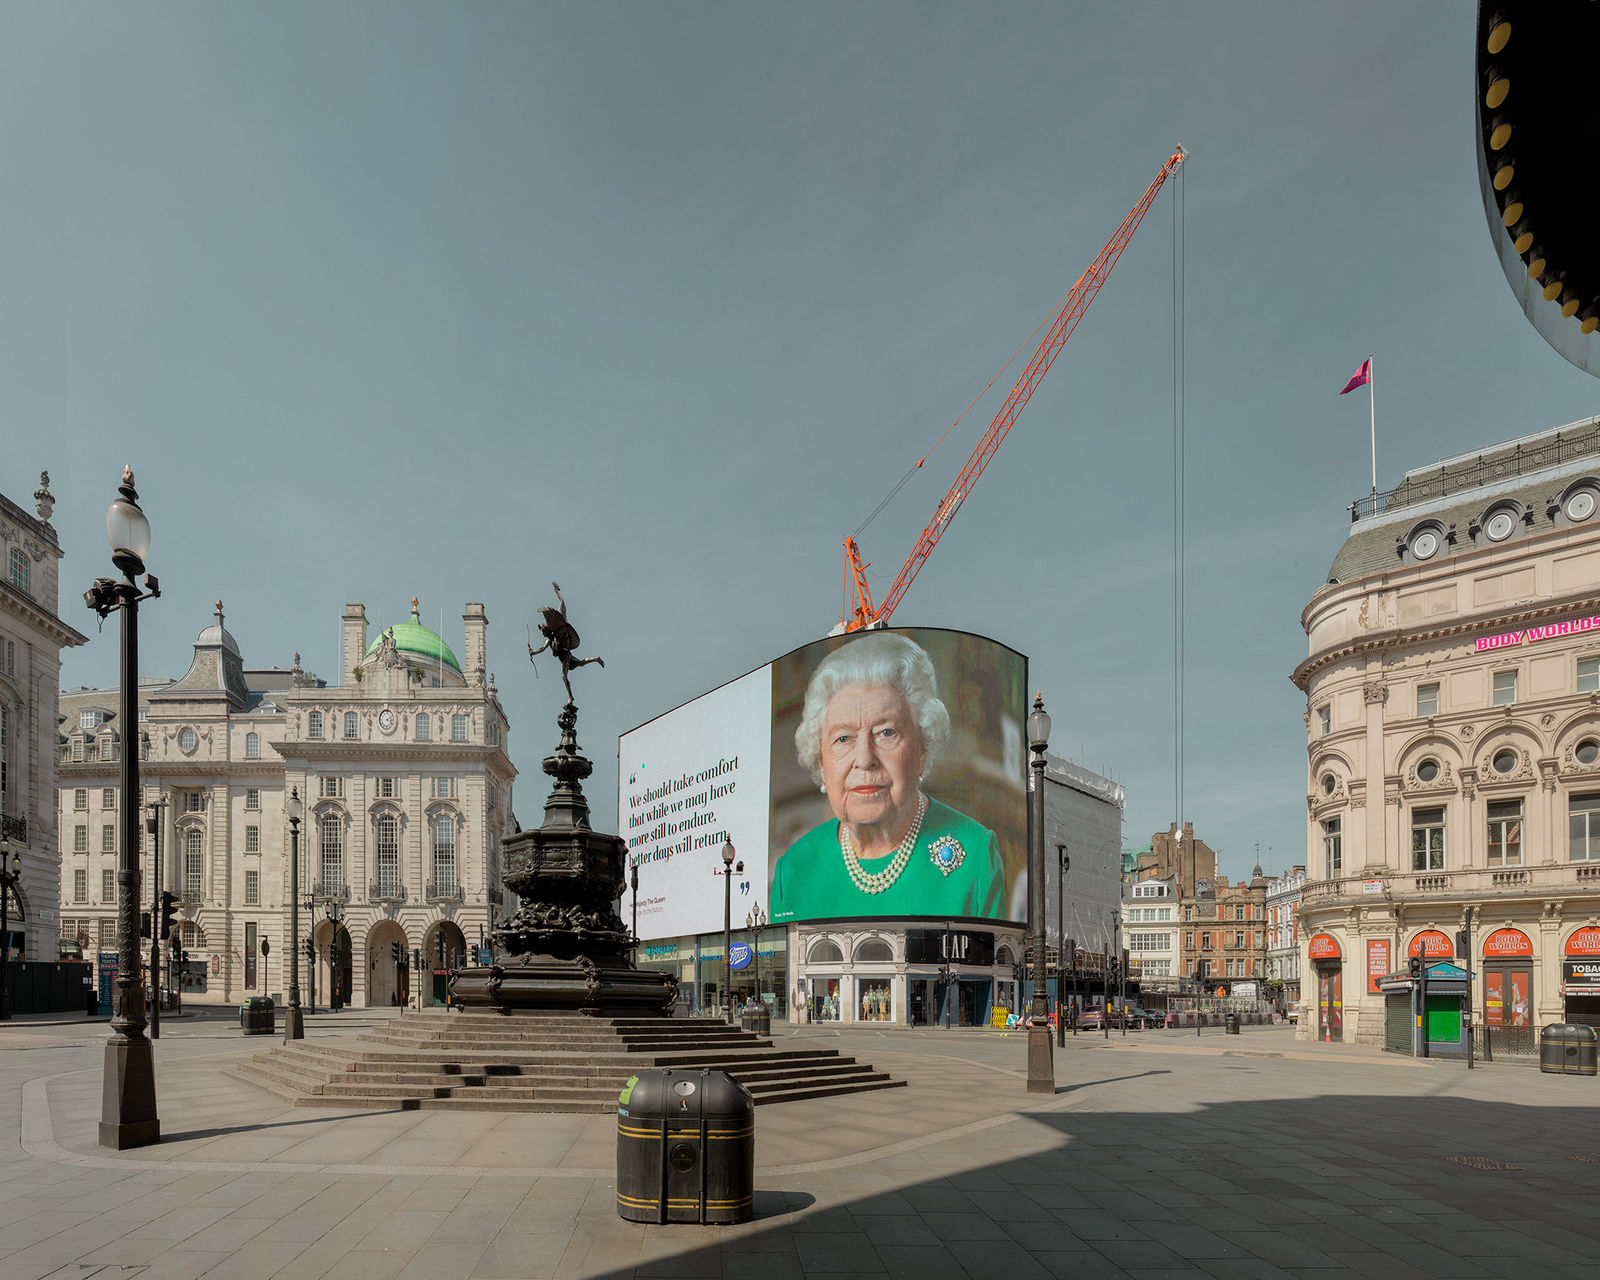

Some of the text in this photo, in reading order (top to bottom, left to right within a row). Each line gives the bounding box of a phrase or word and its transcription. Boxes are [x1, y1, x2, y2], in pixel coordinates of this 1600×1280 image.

[1475, 631, 1524, 652] BODY
[629, 756, 739, 808] We should take comfort
[629, 781, 736, 829] that while we may have
[629, 811, 717, 848] more still to endure,
[628, 851, 652, 867] better
[652, 845, 674, 863] days
[675, 835, 692, 854] will
[651, 944, 676, 956] BARCLAYS
[1496, 934, 1522, 942] BODY
